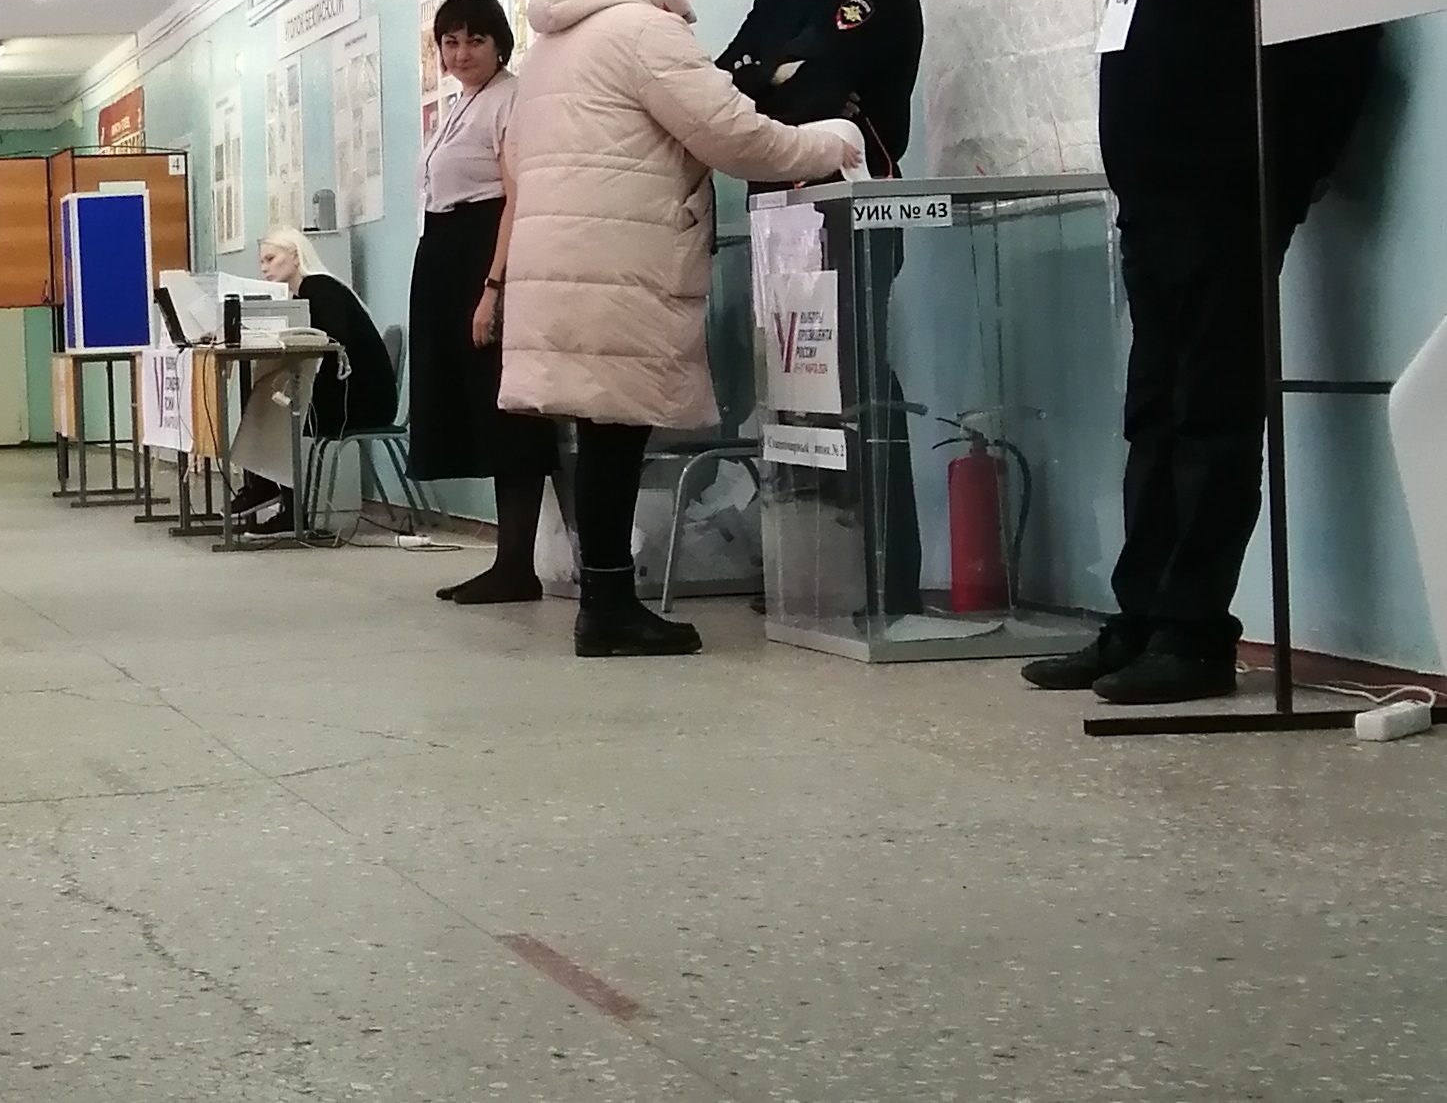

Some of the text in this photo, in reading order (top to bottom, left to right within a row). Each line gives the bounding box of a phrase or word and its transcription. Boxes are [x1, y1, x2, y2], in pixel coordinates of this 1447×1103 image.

[172, 156, 180, 171] 4
[853, 202, 948, 222] УИК № 43
